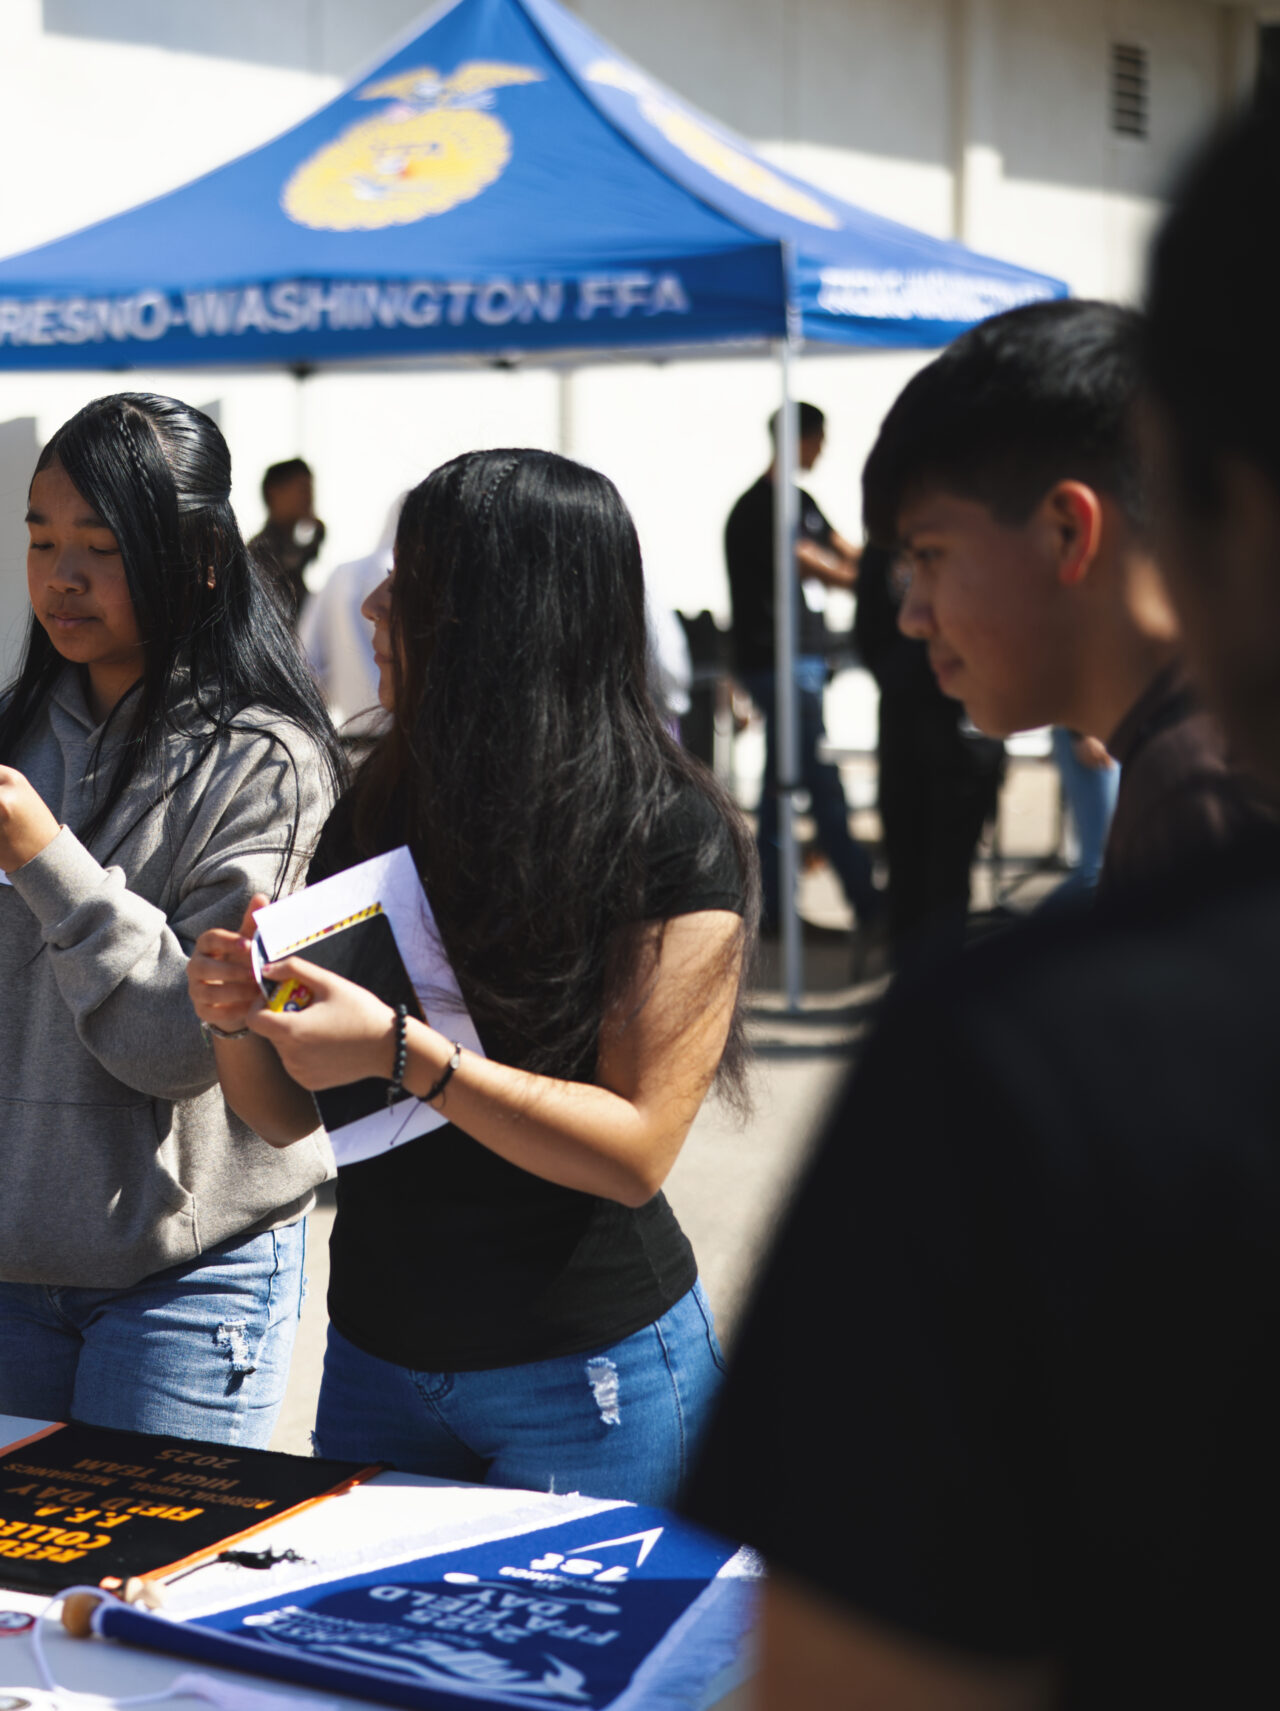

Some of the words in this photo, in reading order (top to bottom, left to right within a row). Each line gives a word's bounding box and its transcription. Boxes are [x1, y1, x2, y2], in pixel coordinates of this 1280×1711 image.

[576, 269, 692, 321] FFA
[74, 1458, 156, 1480] TEAM
[154, 1448, 240, 1469] 2025
[3, 1463, 118, 1486] MECHANICS
[162, 1472, 239, 1491] HIGH
[5, 1483, 94, 1509] DAY
[129, 1481, 276, 1510] AGRICULTURAL
[100, 1497, 204, 1522] FIELD
[369, 1586, 513, 1620] FIELD
[460, 1589, 568, 1616] DAY
[403, 1610, 531, 1644] 2025
[526, 1616, 619, 1645] FFA
